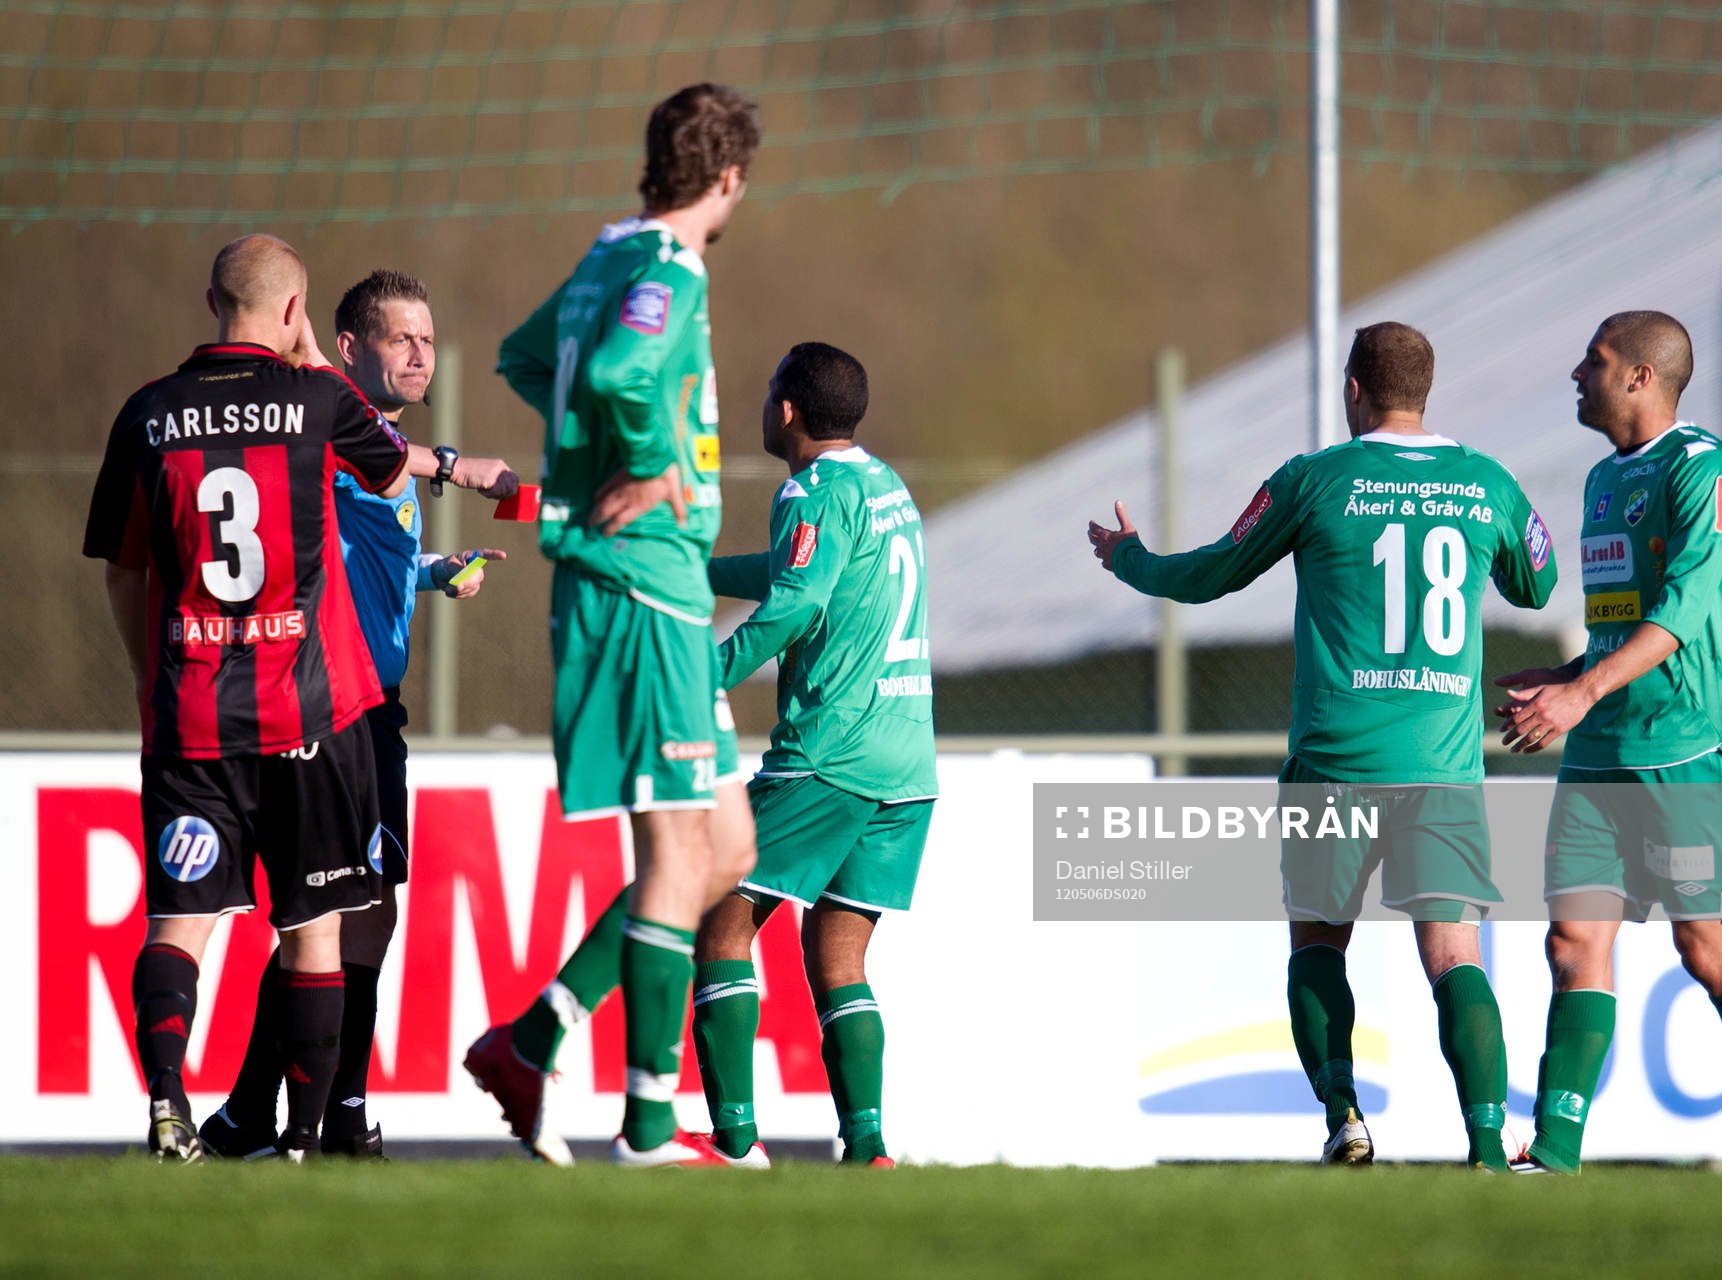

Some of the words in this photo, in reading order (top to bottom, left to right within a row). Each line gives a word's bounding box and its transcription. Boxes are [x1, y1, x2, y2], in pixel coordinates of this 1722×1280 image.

[146, 403, 304, 447] CARLSSON
[1352, 478, 1486, 499] Stenungsunds
[1236, 498, 1269, 538] Adecco
[1343, 495, 1395, 517] Åkeri
[1400, 500, 1416, 516] &
[1421, 500, 1465, 517] Gräv
[1468, 503, 1493, 524] AB
[197, 466, 265, 602] 3
[1372, 523, 1468, 658] 18
[1602, 603, 1634, 618] BYGG
[172, 615, 303, 642] BAUHAUS
[164, 816, 214, 881] hp
